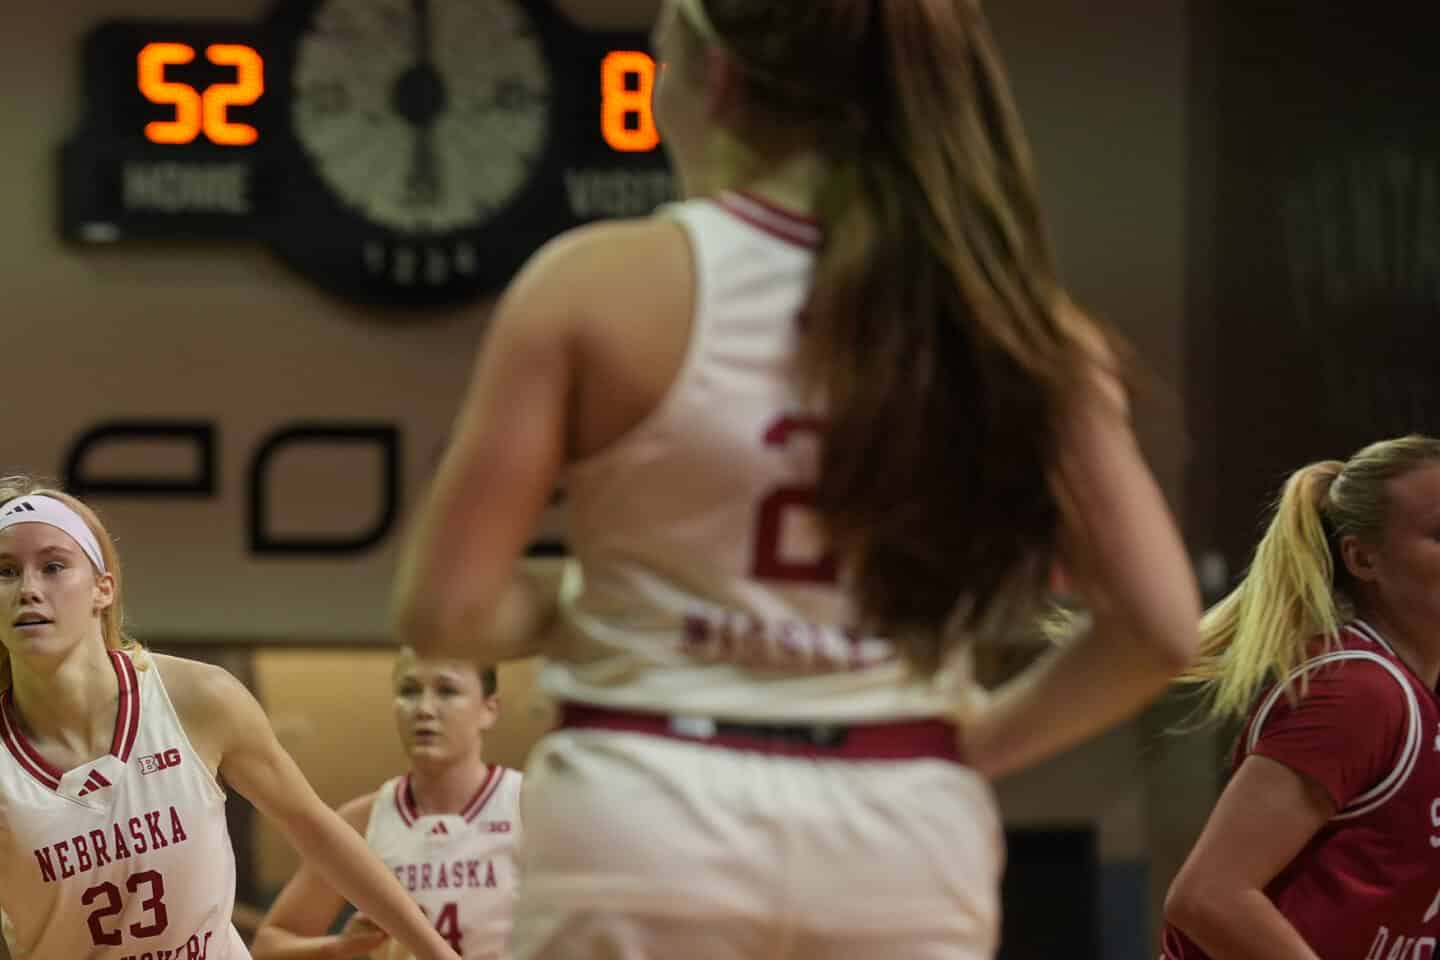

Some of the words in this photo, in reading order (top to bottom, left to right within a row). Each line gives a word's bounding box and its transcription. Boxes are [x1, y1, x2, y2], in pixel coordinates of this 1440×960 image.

[137, 42, 263, 145] 52
[34, 806, 187, 882] NEBRASKA
[394, 860, 497, 892] EBRASKA
[81, 870, 168, 946] 23
